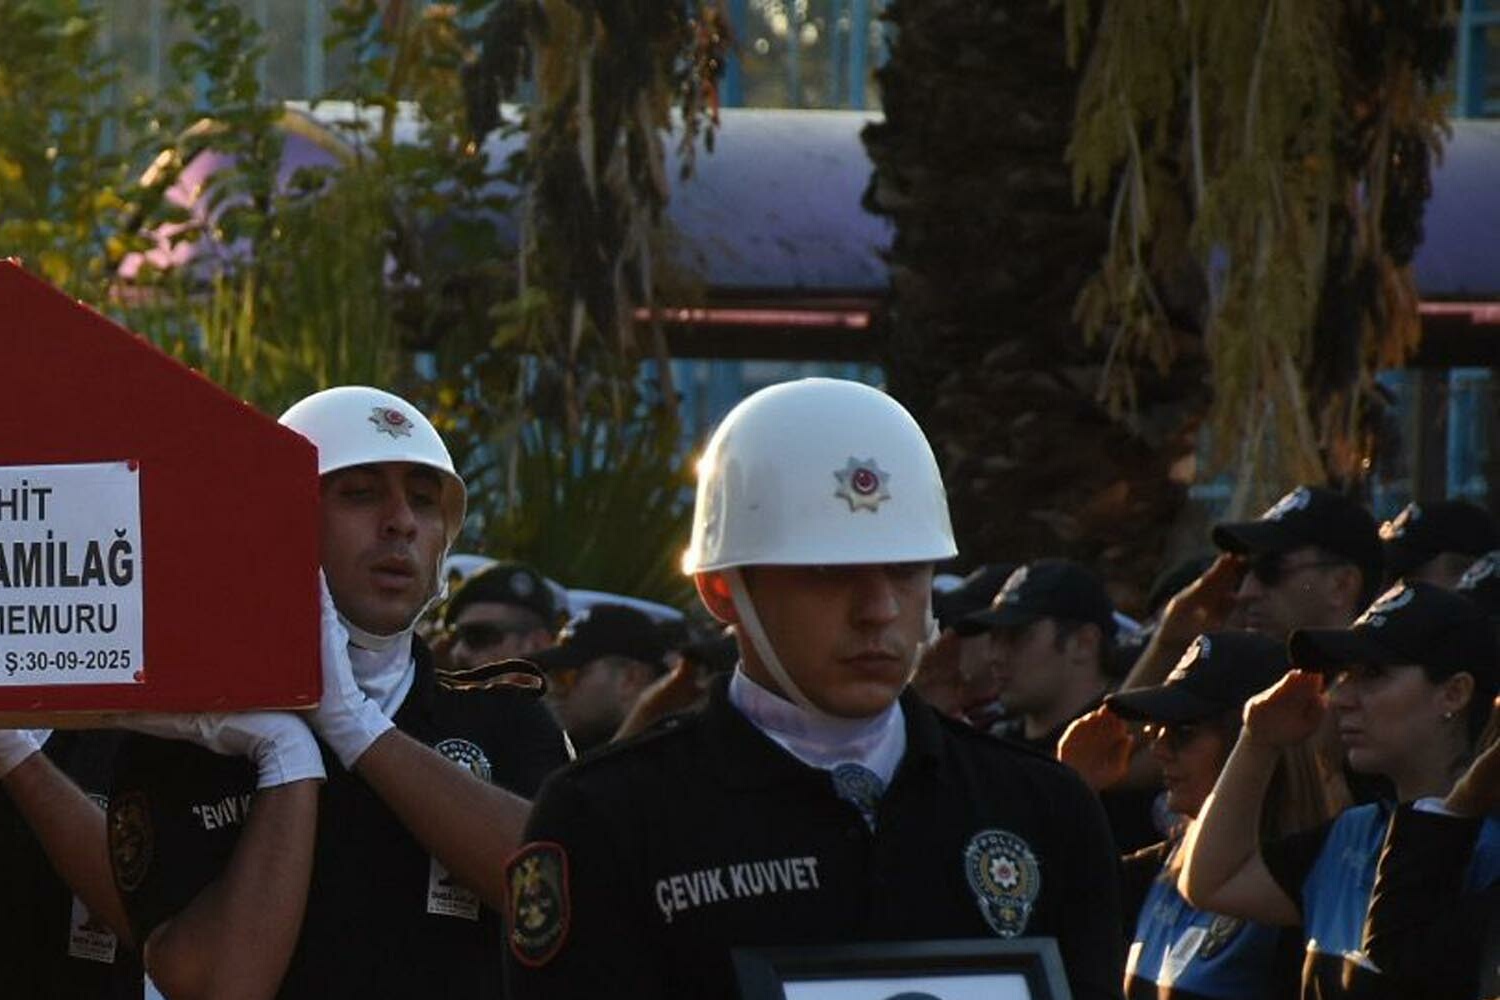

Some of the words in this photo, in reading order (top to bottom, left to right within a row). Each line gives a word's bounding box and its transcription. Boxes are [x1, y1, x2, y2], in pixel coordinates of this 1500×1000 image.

[5, 649, 131, 676] Ş:30-09-2025
[655, 867, 730, 924] ÇEVİK
[728, 856, 821, 897] KUVVET
